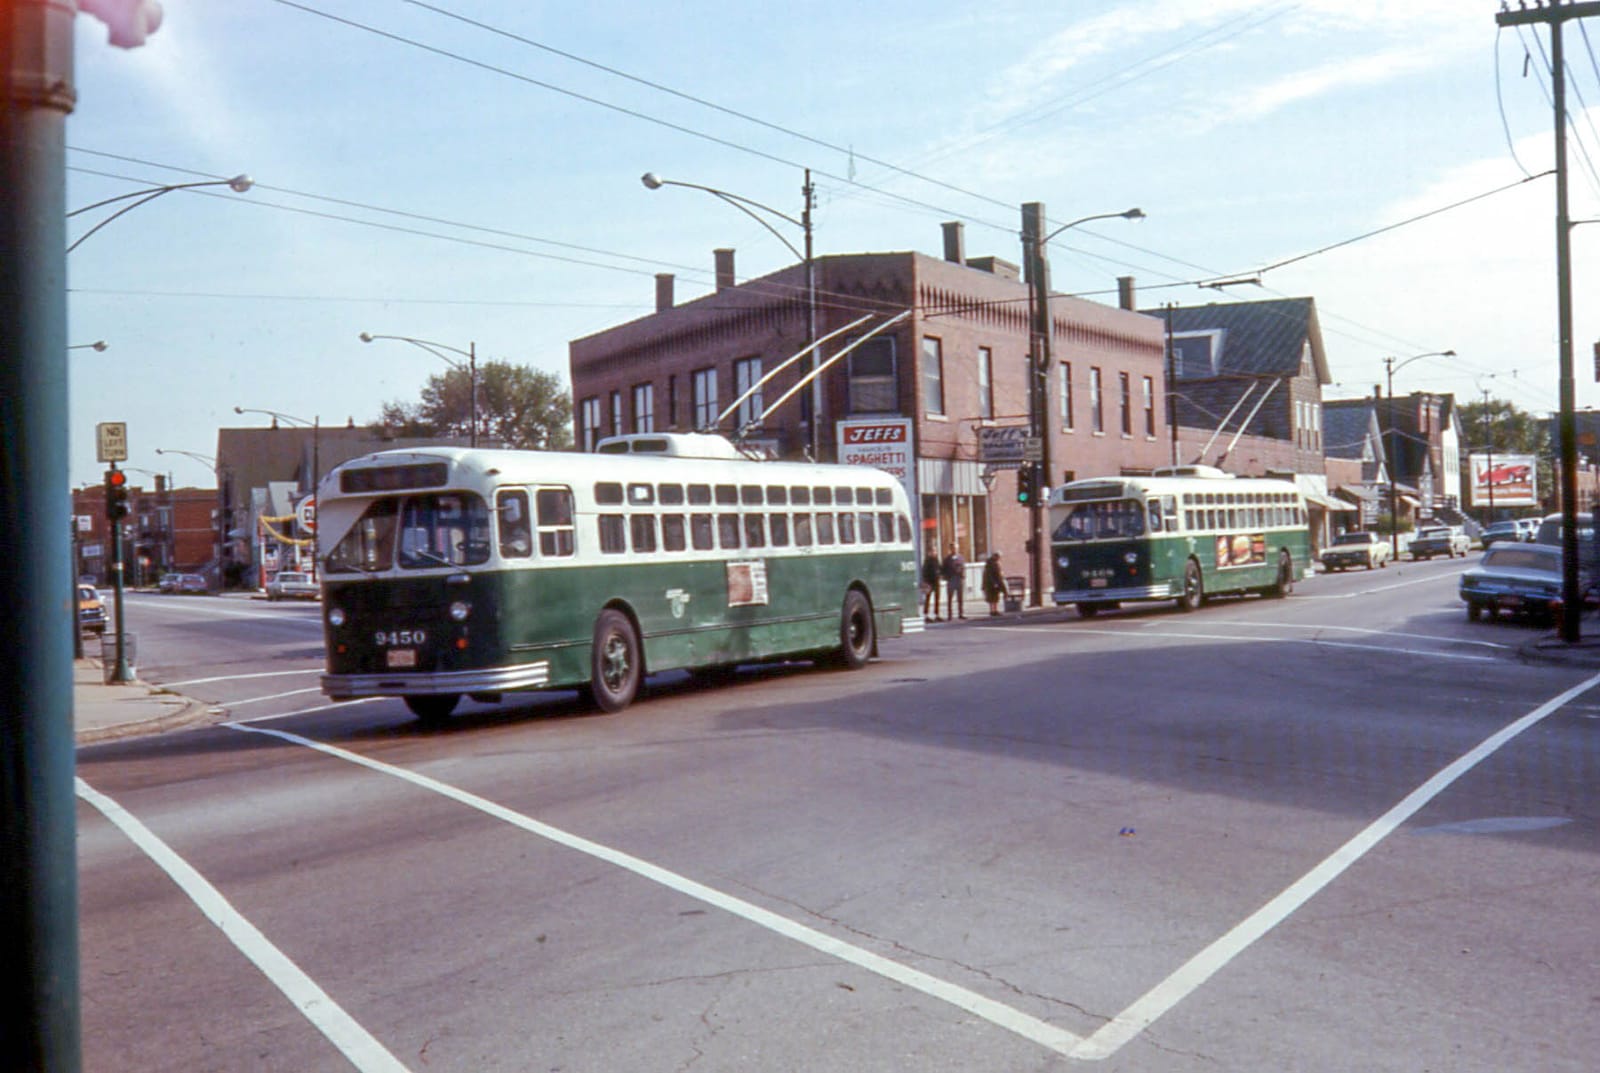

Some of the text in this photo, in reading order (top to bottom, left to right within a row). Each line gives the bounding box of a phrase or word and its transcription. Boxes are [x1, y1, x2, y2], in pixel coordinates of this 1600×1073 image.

[106, 427, 121, 437] NO
[846, 452, 906, 466] SPAGHETTI
[375, 630, 426, 646] 9450
